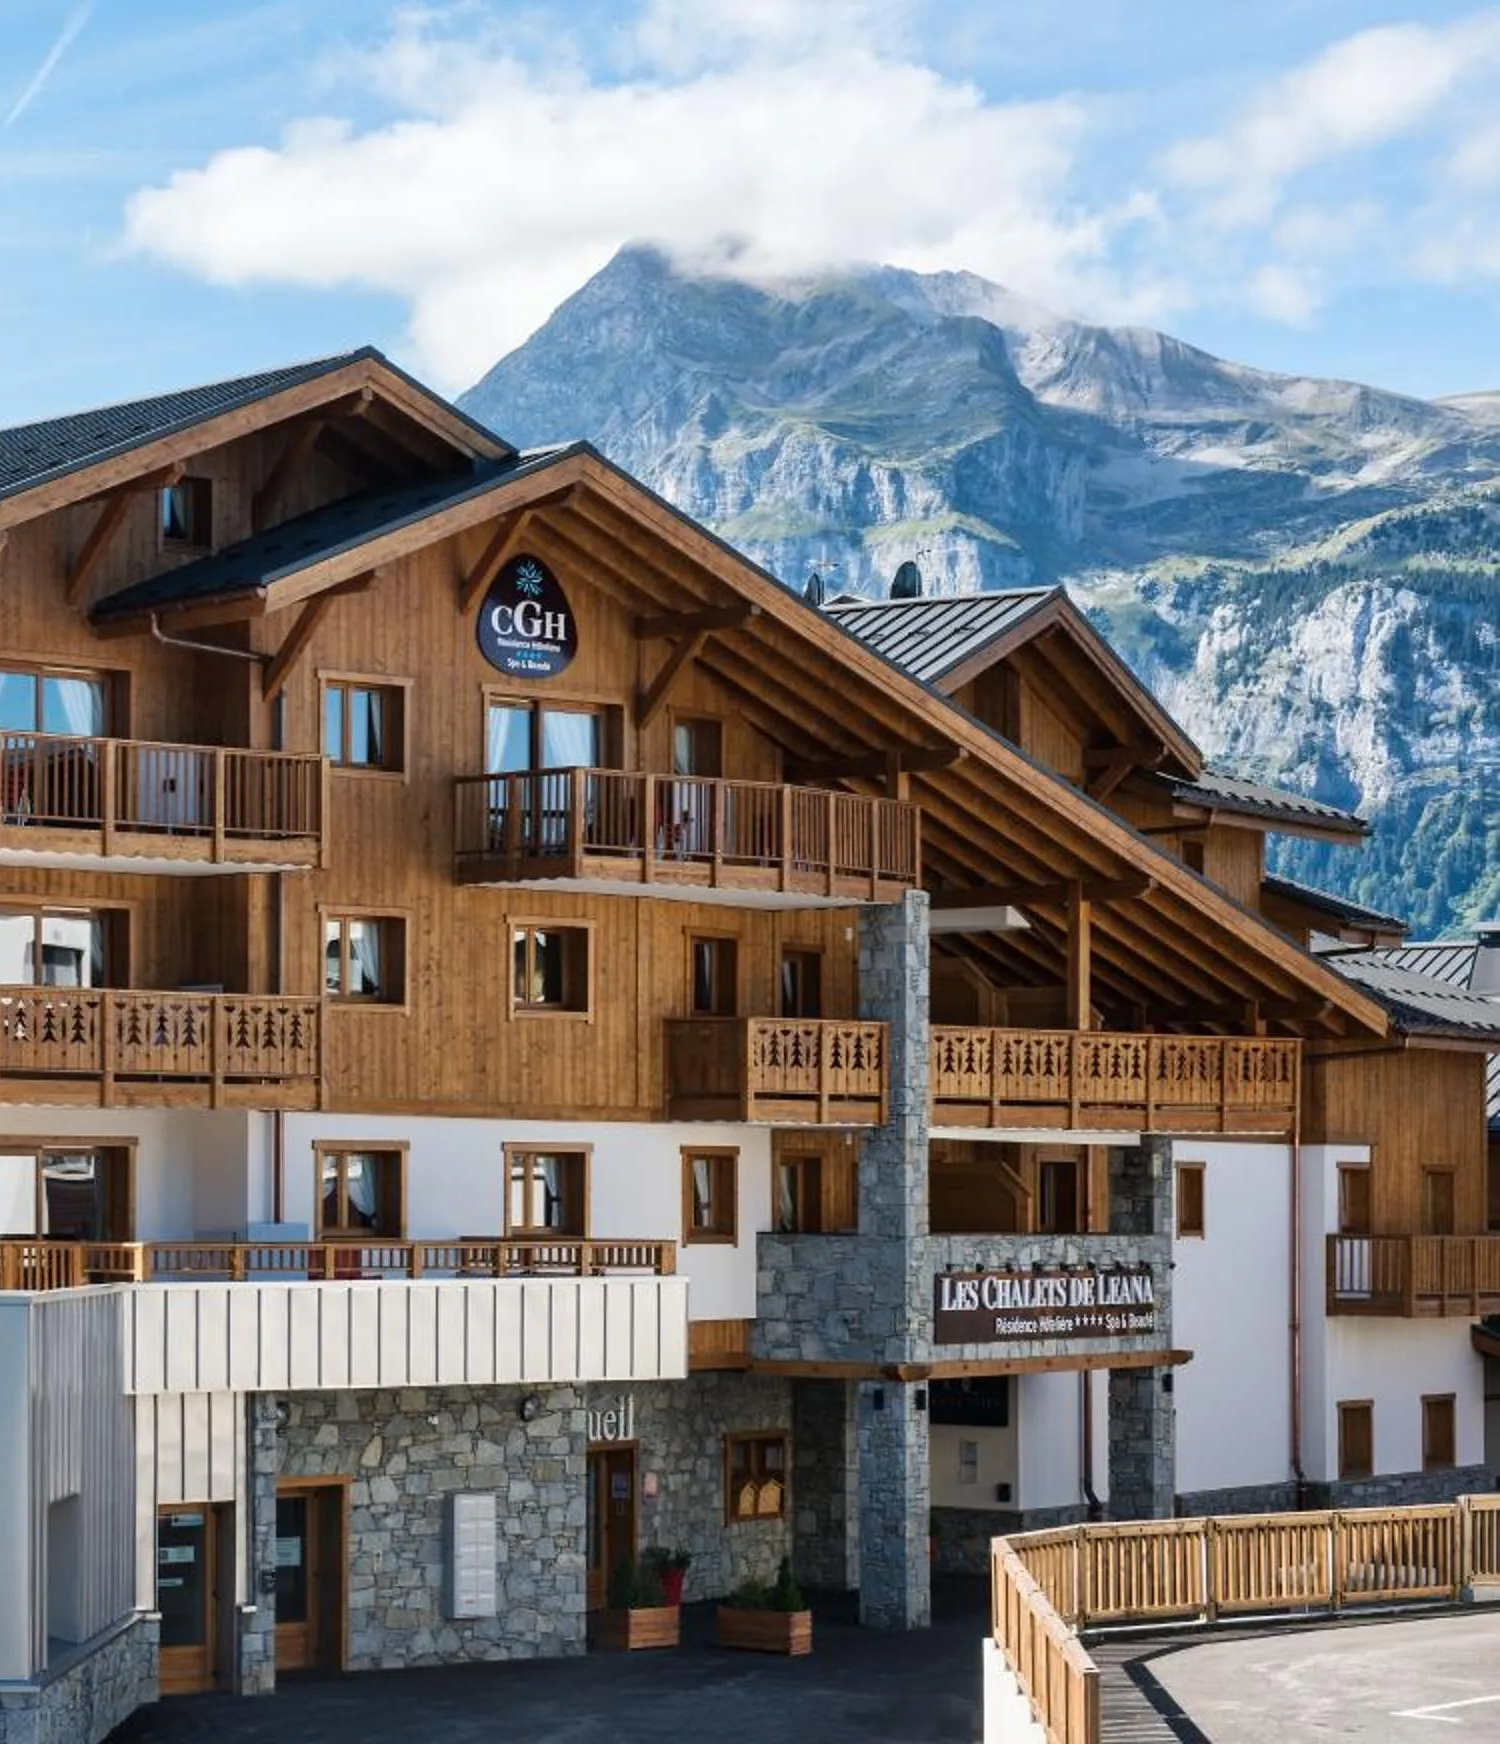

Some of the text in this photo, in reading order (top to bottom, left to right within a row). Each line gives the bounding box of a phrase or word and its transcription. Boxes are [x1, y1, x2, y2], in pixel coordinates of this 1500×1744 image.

[491, 600, 567, 641] CGH
[940, 1273, 1154, 1311] LES CHALETS DE LEANA
[1105, 1313, 1120, 1331] Spa
